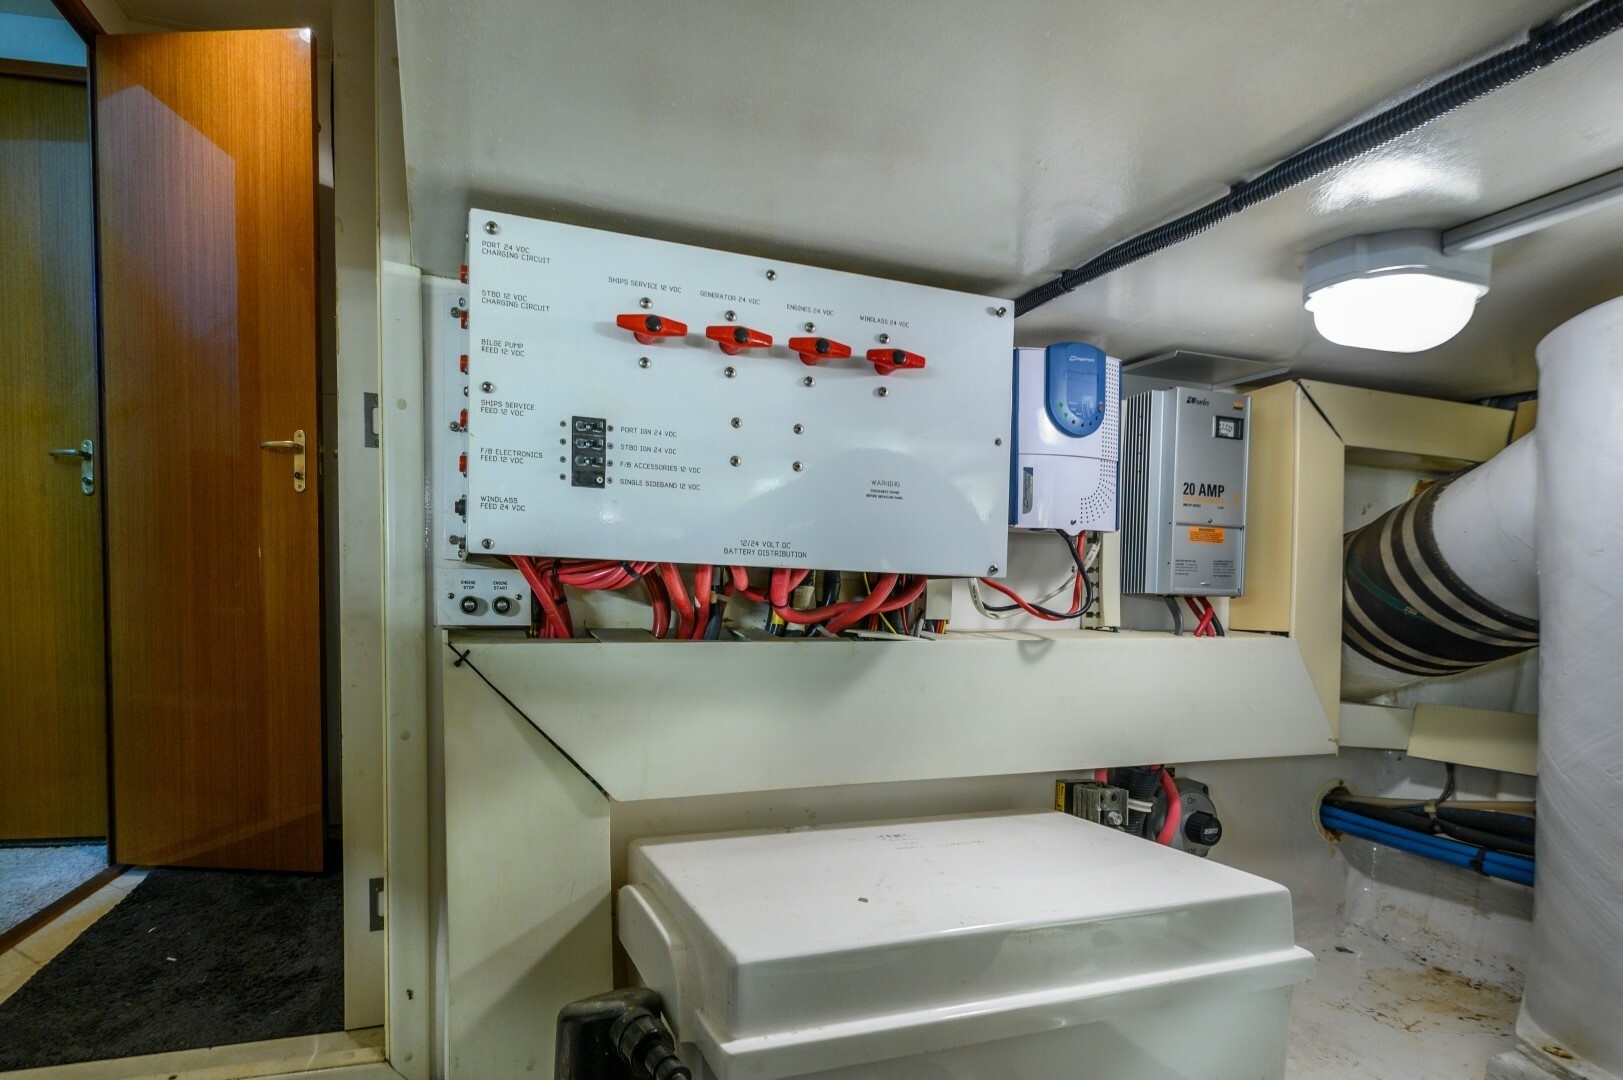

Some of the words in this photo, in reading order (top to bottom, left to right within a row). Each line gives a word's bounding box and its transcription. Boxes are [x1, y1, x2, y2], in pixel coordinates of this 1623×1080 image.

[482, 240, 500, 249] PORT
[482, 248, 518, 260] CHARGING
[521, 255, 550, 264] CIRCUIT
[608, 276, 628, 286] SHIPS
[630, 280, 658, 290] SERVICE
[482, 290, 500, 298] STBD
[700, 290, 736, 301] GENERATOR
[482, 298, 518, 308] CHARGING
[521, 303, 550, 312] CIRCUIT
[786, 304, 812, 313] ENGINES
[860, 315, 888, 325] WINDLASS
[481, 339, 502, 348] BILGE
[481, 346, 498, 354] FEED
[480, 400, 502, 408] SHIPS
[505, 402, 535, 410] SERVICE
[496, 448, 543, 458] ELECTRONICS
[634, 462, 678, 472] ACCESSORIES
[620, 478, 642, 486] SINGLE
[645, 480, 678, 489] SIDEBAND
[1183, 482, 1195, 496] 20
[1198, 483, 1225, 498] AMP
[480, 496, 518, 504] WINDLASS
[723, 548, 755, 556] BATTERY
[758, 549, 807, 558] DISTRIBUTION
